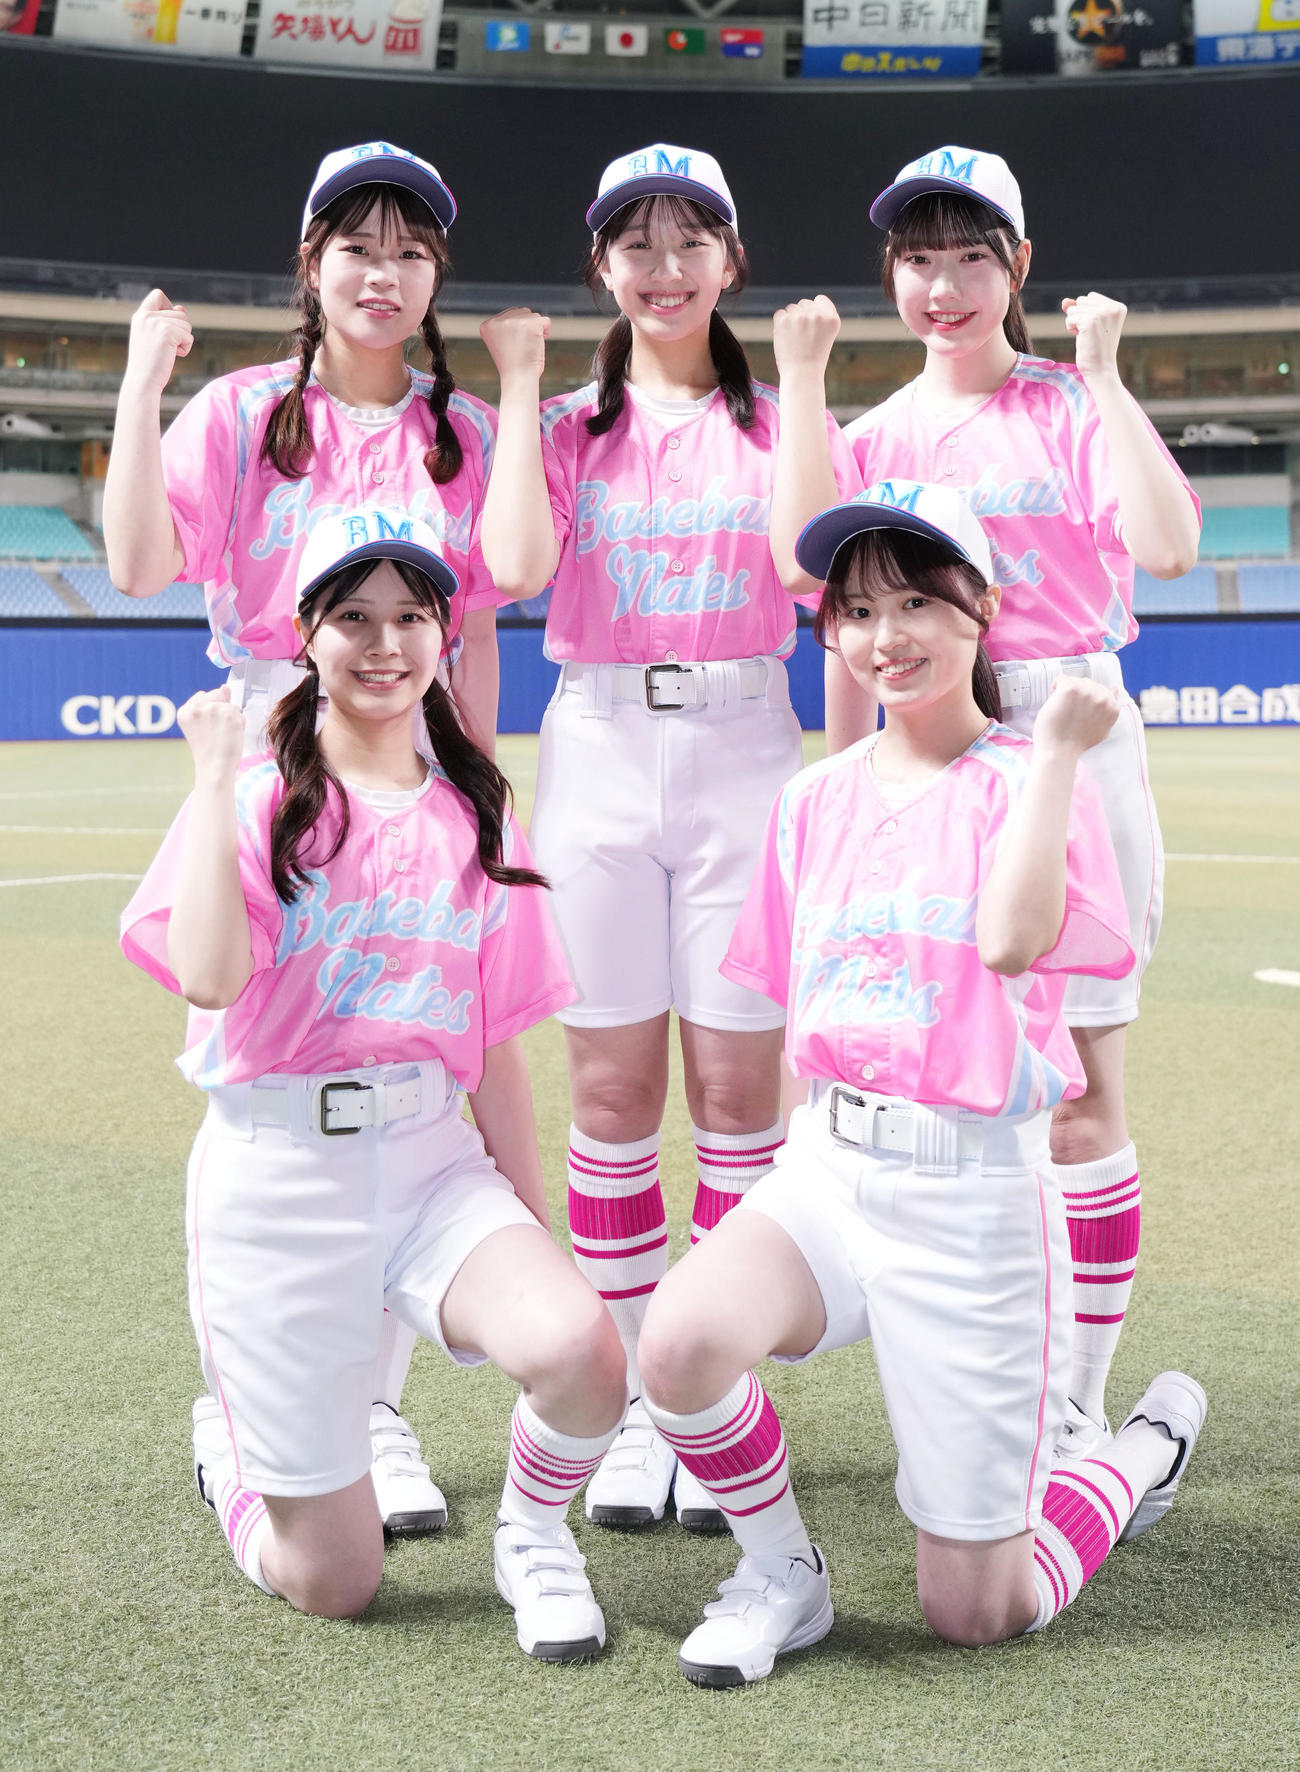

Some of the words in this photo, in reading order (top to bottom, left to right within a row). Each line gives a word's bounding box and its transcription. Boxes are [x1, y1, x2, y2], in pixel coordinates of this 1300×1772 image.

[271, 12, 376, 45] 矢場とん
[812, 0, 979, 32] 中日新聞
[342, 511, 414, 551] BM
[60, 694, 176, 735] CKD
